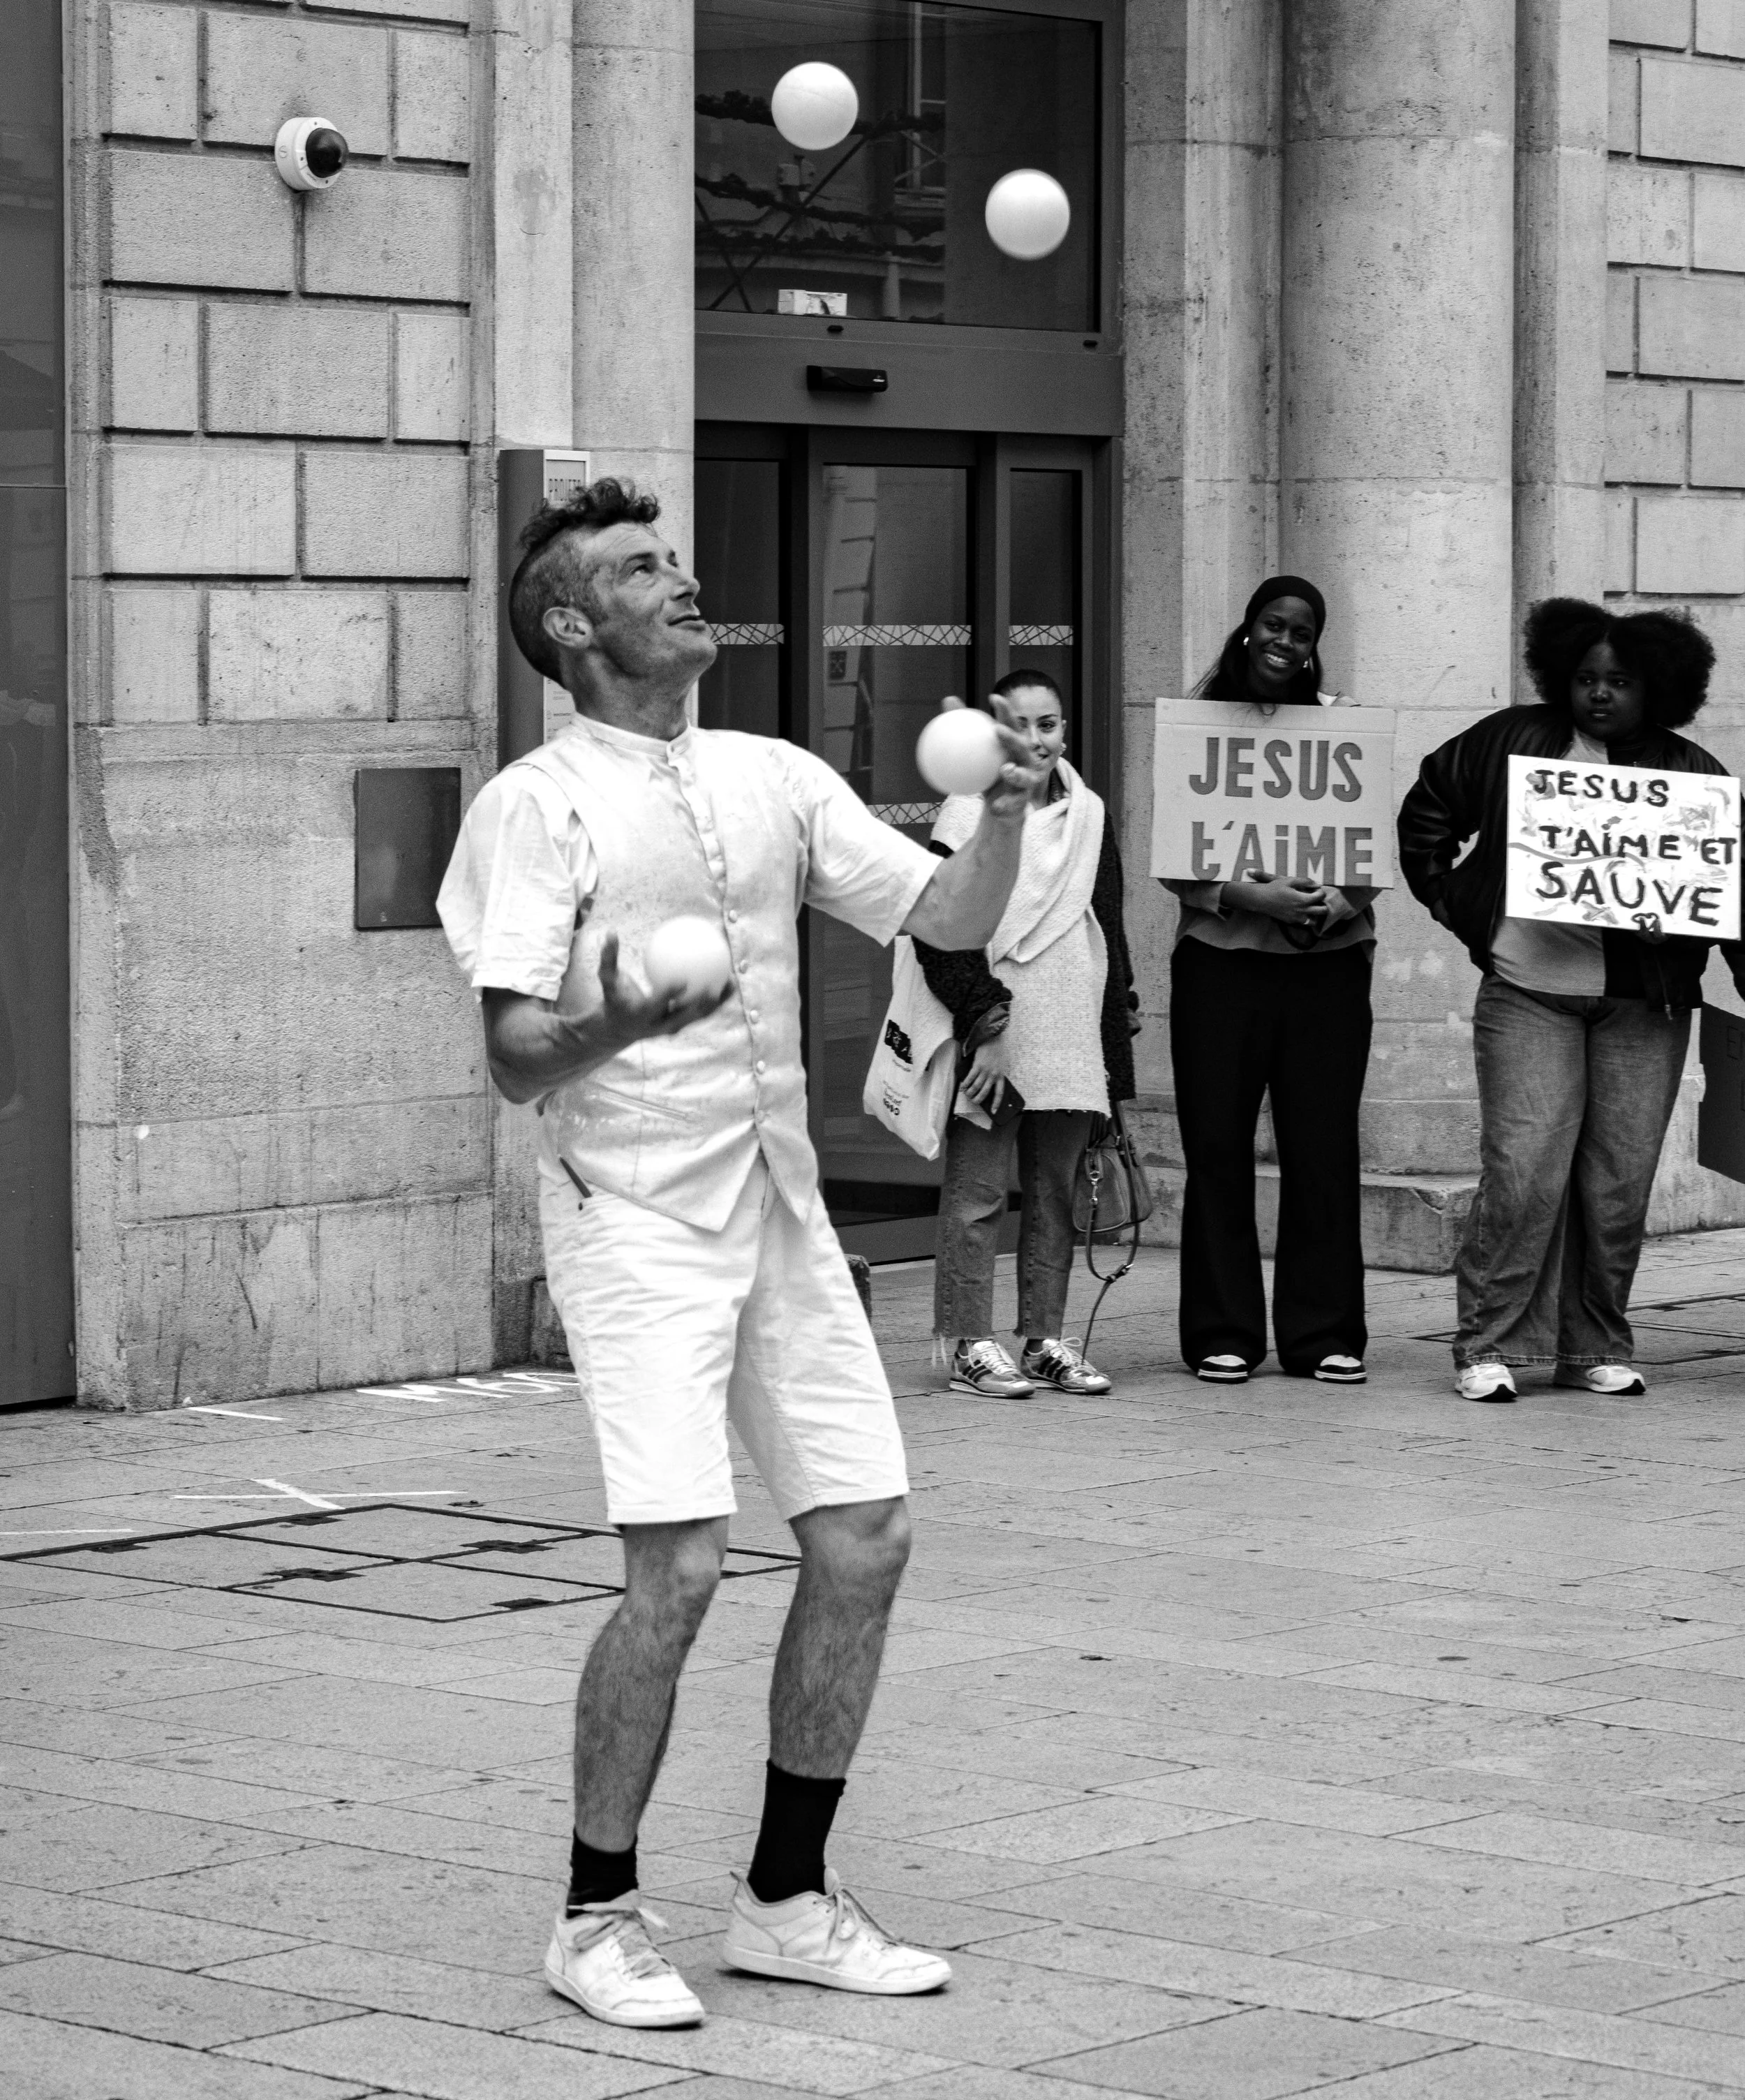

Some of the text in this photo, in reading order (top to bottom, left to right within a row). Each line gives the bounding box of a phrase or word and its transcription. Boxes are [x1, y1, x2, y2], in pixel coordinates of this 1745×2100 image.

[1188, 737, 1362, 802] JESUS
[1534, 769, 1669, 808] JESUS
[1701, 837, 1737, 865] ET
[1536, 861, 1723, 926] SAUVE
